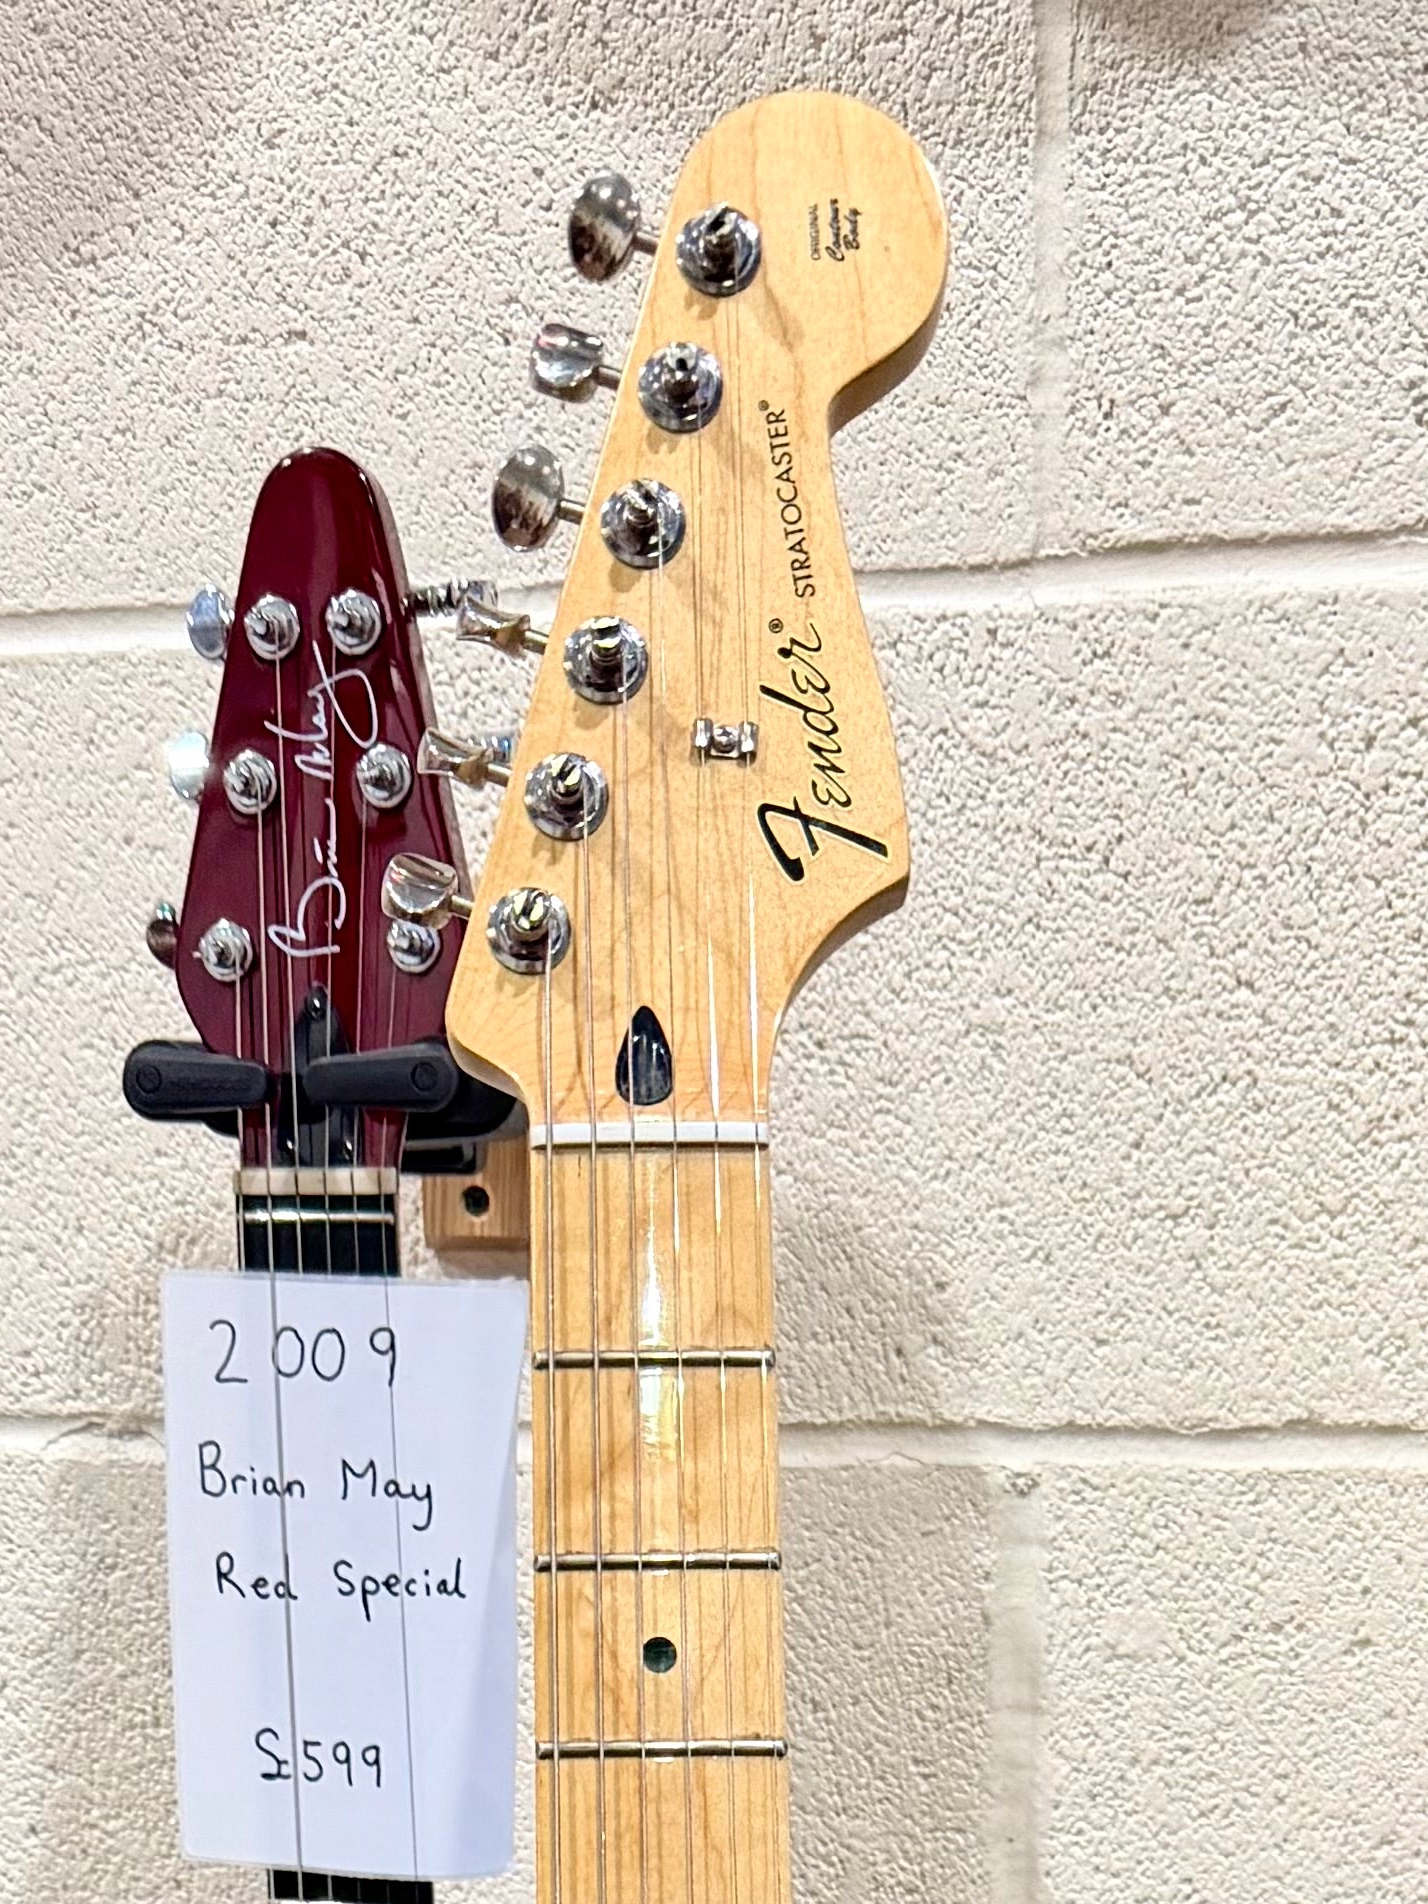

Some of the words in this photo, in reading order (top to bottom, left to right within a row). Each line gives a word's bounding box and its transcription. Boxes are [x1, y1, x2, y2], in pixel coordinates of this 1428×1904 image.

[767, 408, 816, 599] STRATOCASTER
[757, 620, 888, 881] Fender
[209, 1319, 398, 1387] 2009
[198, 1440, 306, 1500] Brian
[339, 1458, 433, 1531] May
[215, 1552, 298, 1601] Red
[333, 1558, 467, 1622] Special
[255, 1727, 383, 1788] £599
